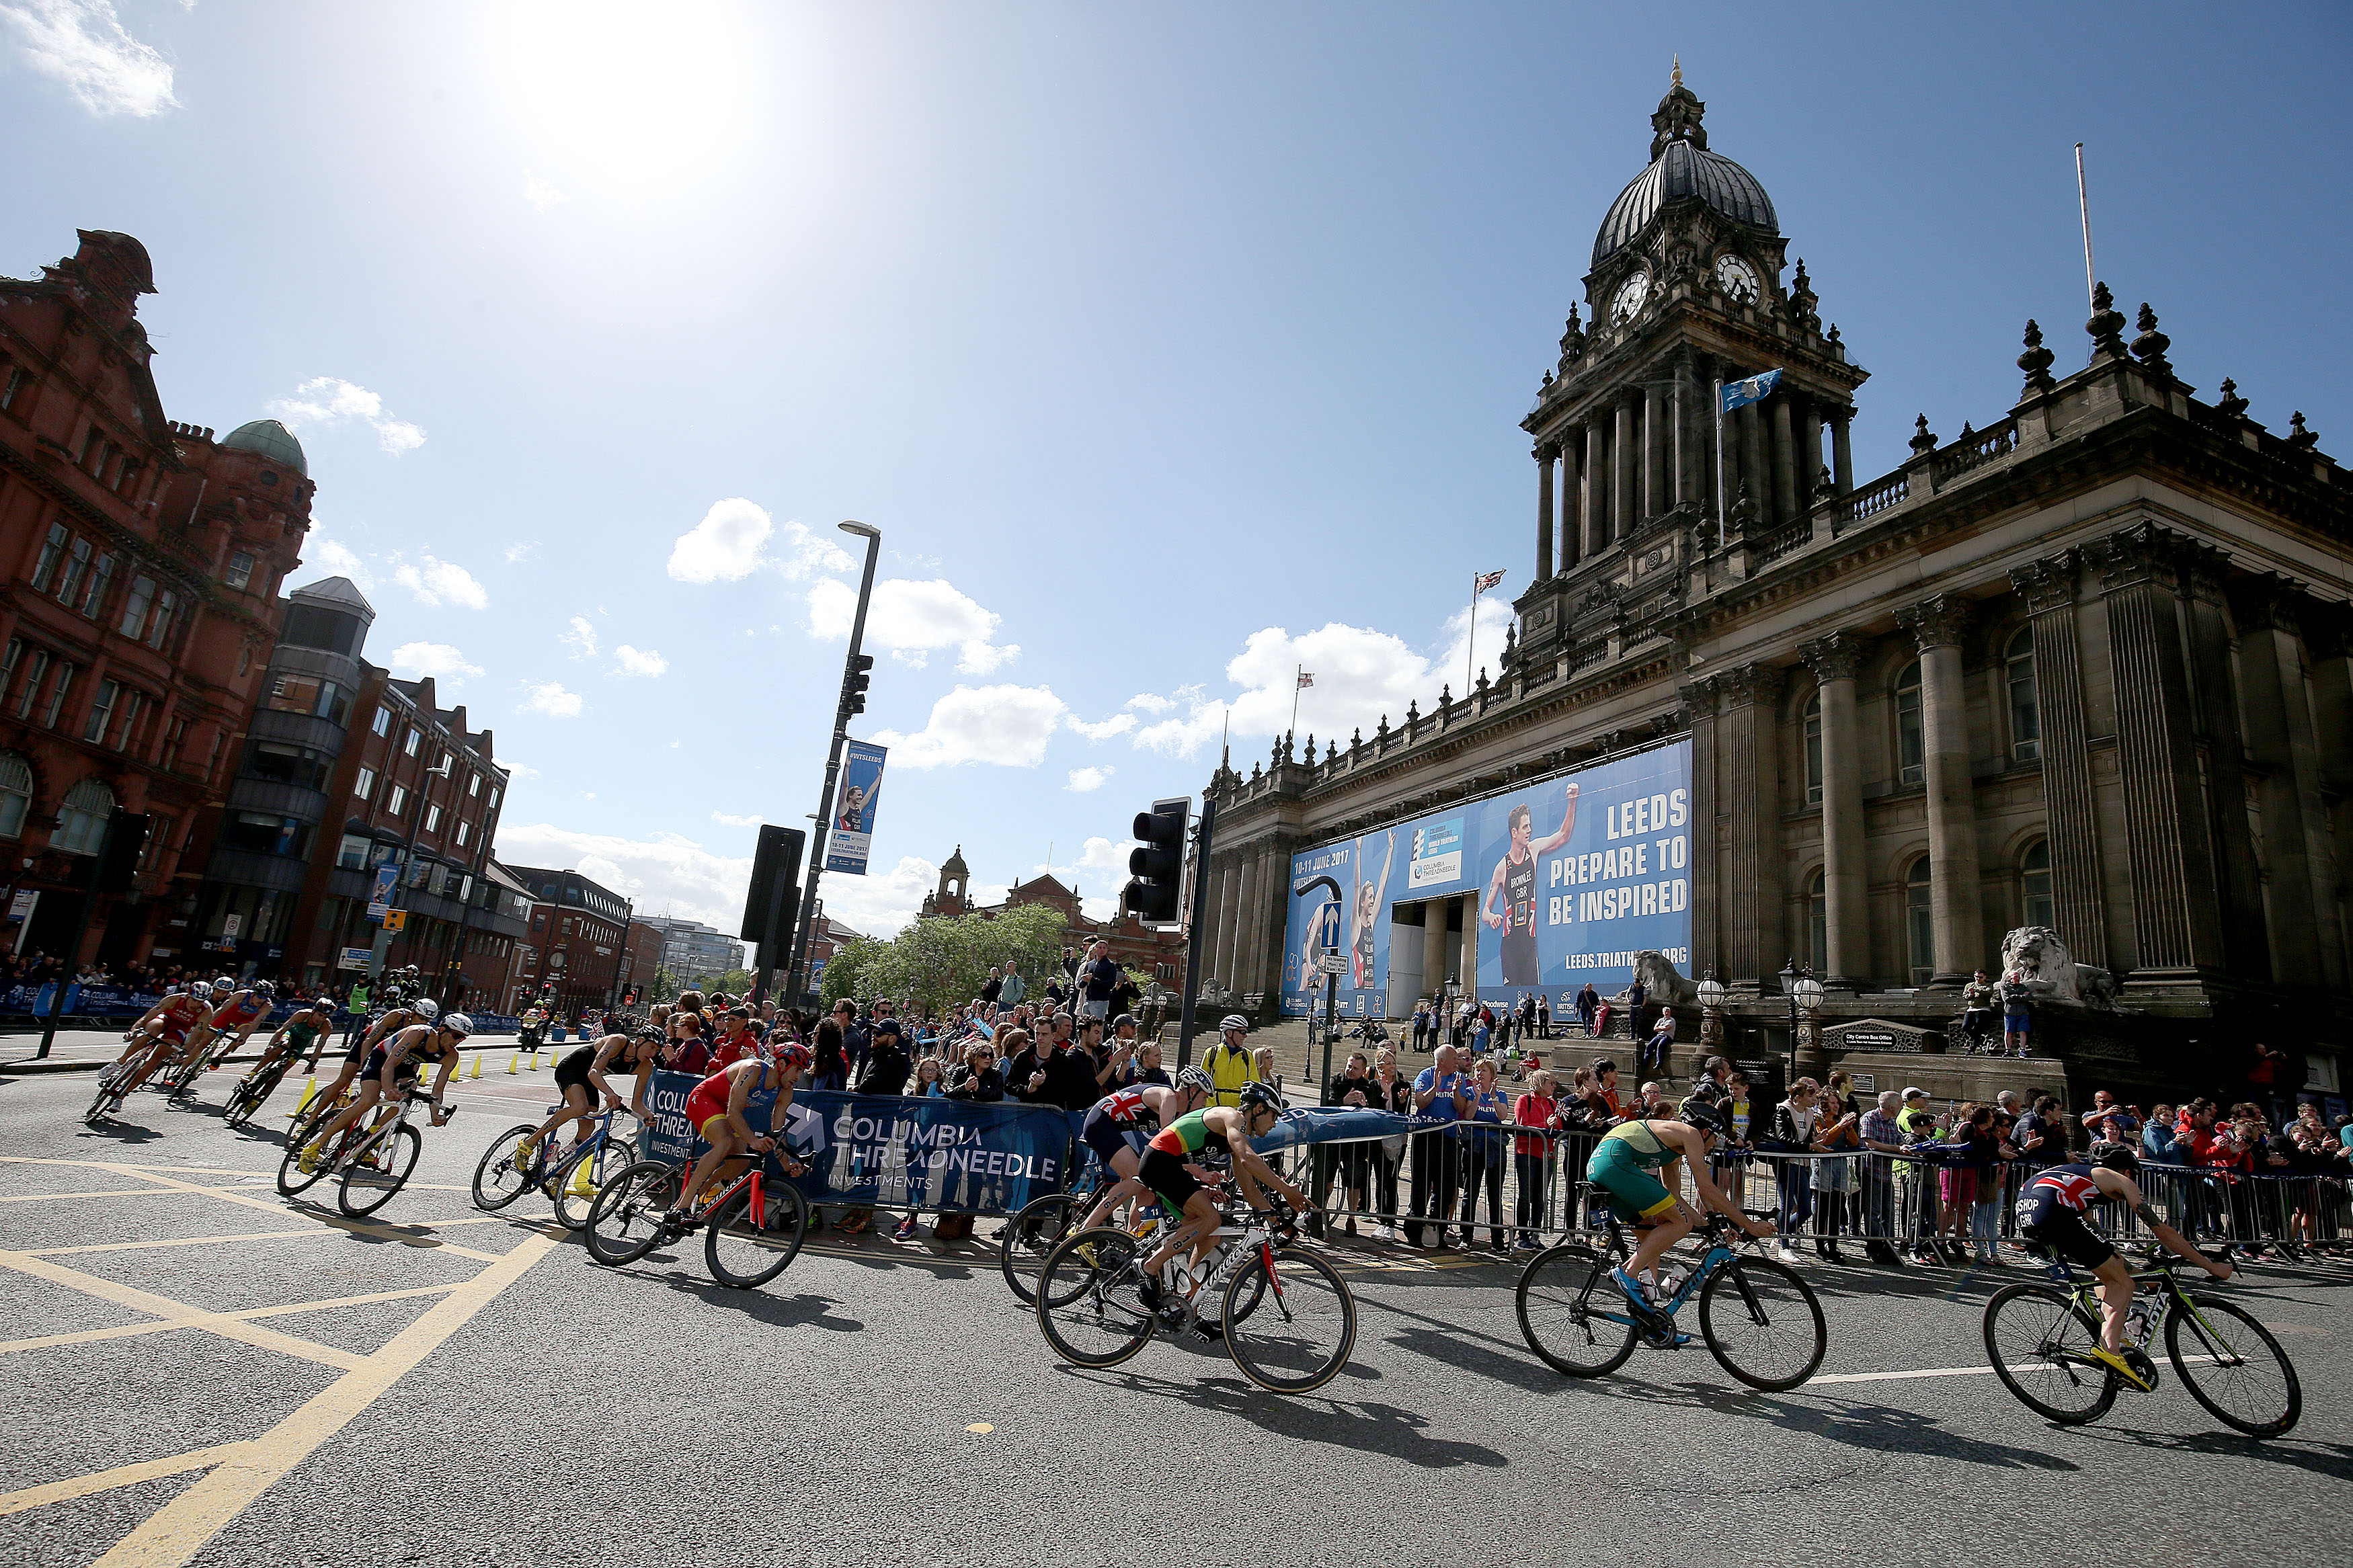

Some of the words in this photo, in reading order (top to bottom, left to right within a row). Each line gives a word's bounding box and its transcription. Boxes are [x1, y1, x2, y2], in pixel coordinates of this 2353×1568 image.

[850, 753, 882, 764] #WTSLEEDS
[1607, 788, 1687, 841] LEEDS
[1295, 859, 1312, 875] 10-11
[1312, 854, 1330, 872] JUNE
[1331, 849, 1350, 867] 2017
[1423, 861, 1445, 871] COLUMBIA
[1423, 864, 1456, 877] THREADNEEDLE
[1550, 843, 1647, 889] PREPARE
[1656, 835, 1687, 872] TO
[1511, 870, 1532, 889] BROWNLEE
[1515, 885, 1527, 899] GBR
[1549, 895, 1573, 926] BE
[1579, 878, 1687, 923] INSPIRED
[1565, 946, 1687, 970] LEEDS.TRIATHORG
[740, 1074, 750, 1087] 11
[833, 1116, 982, 1147] COLUMBIA
[832, 1142, 1056, 1182] THREADNEEDLE
[1094, 1165, 1103, 1173] 16
[828, 1173, 934, 1191] INVESTMENTS
[1103, 1197, 1118, 1209] 16
[1599, 1210, 1609, 1219] 27
[2020, 1213, 2034, 1226] GBR
[2077, 1216, 2106, 1243] HUUB
[1172, 1235, 1191, 1251] 18
[1200, 1234, 1250, 1292] Wilier
[2057, 1266, 2065, 1274] 3
[1677, 1264, 1710, 1305] GIANT
[2139, 1292, 2170, 1354] KUOTA
